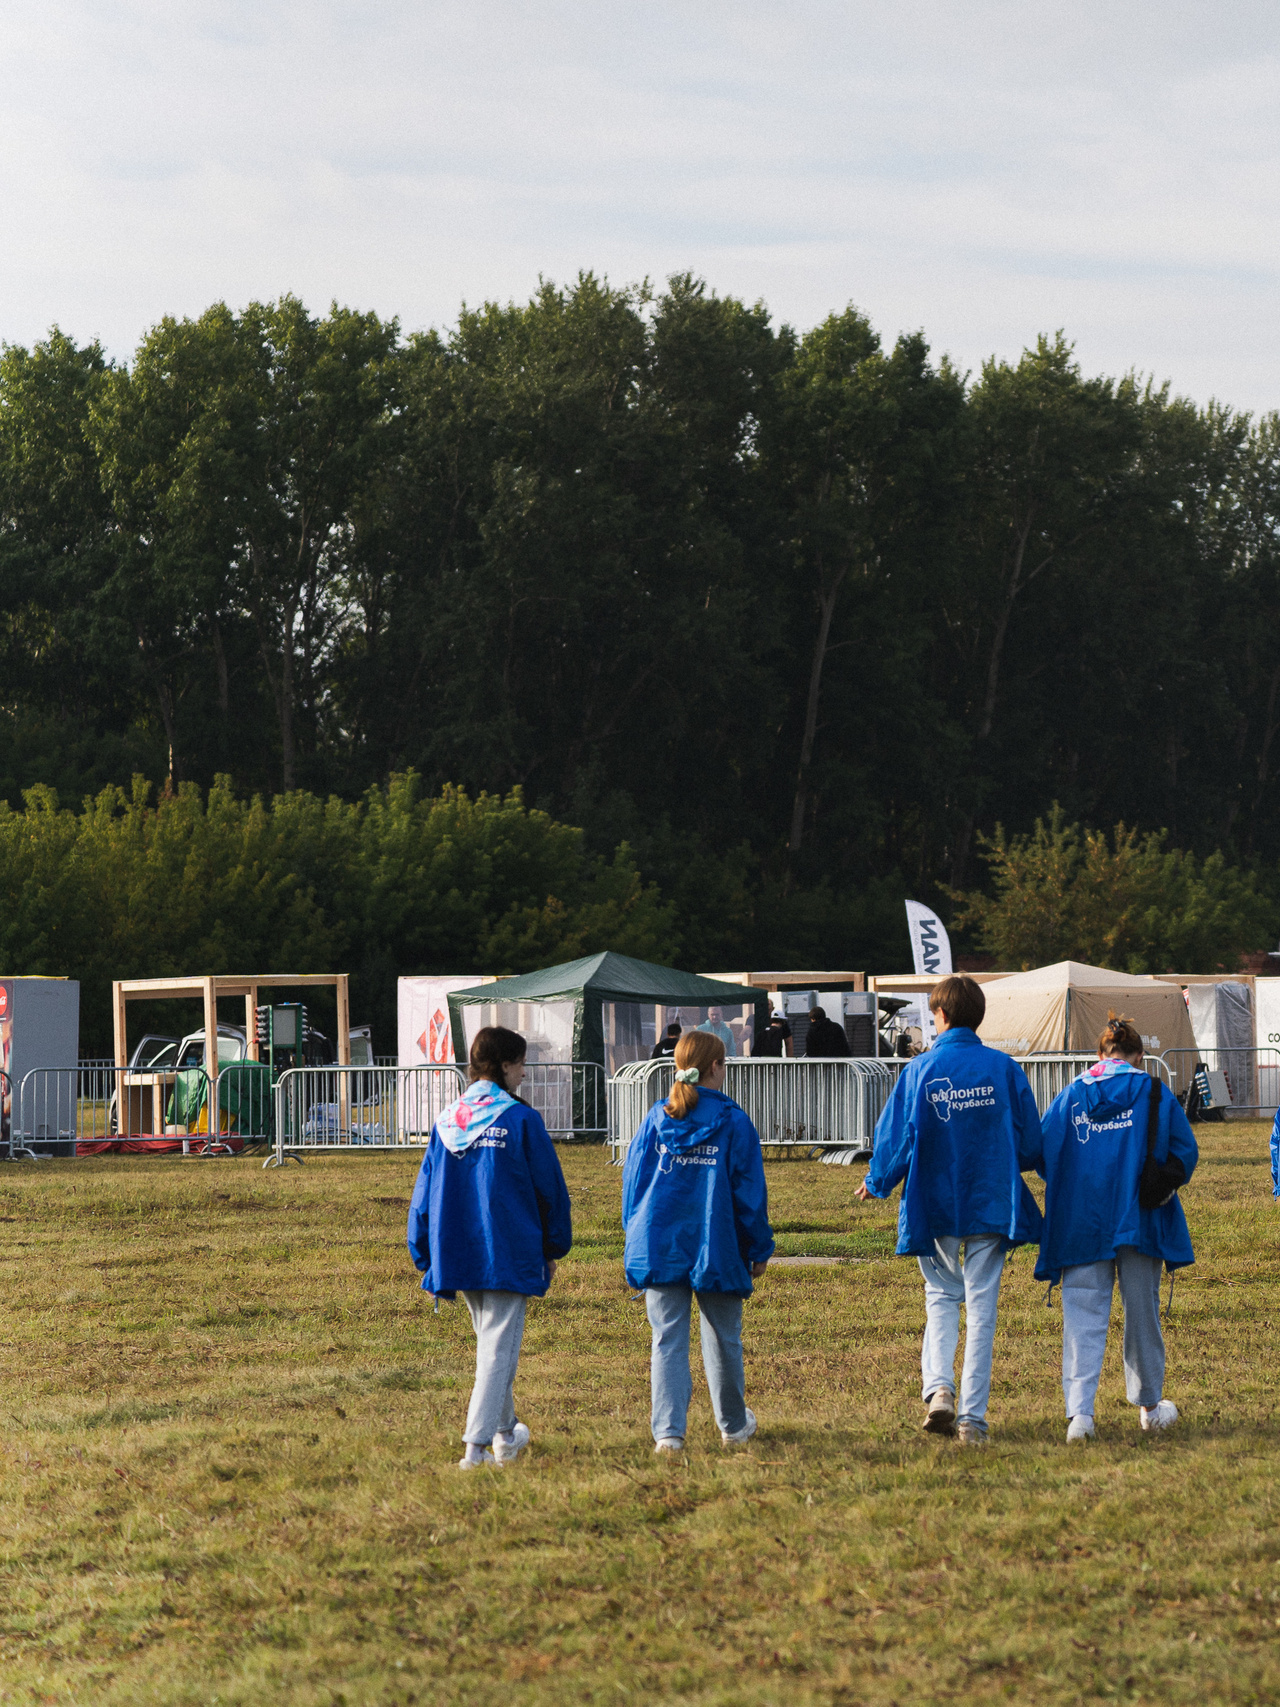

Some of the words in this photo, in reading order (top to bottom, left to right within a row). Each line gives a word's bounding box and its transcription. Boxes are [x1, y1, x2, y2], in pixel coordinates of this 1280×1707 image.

[952, 1098, 996, 1111] Кузбасса
[1092, 1120, 1133, 1133] Кузбасса
[472, 1138, 506, 1149] узбасса
[676, 1155, 717, 1166] Кузбасса
